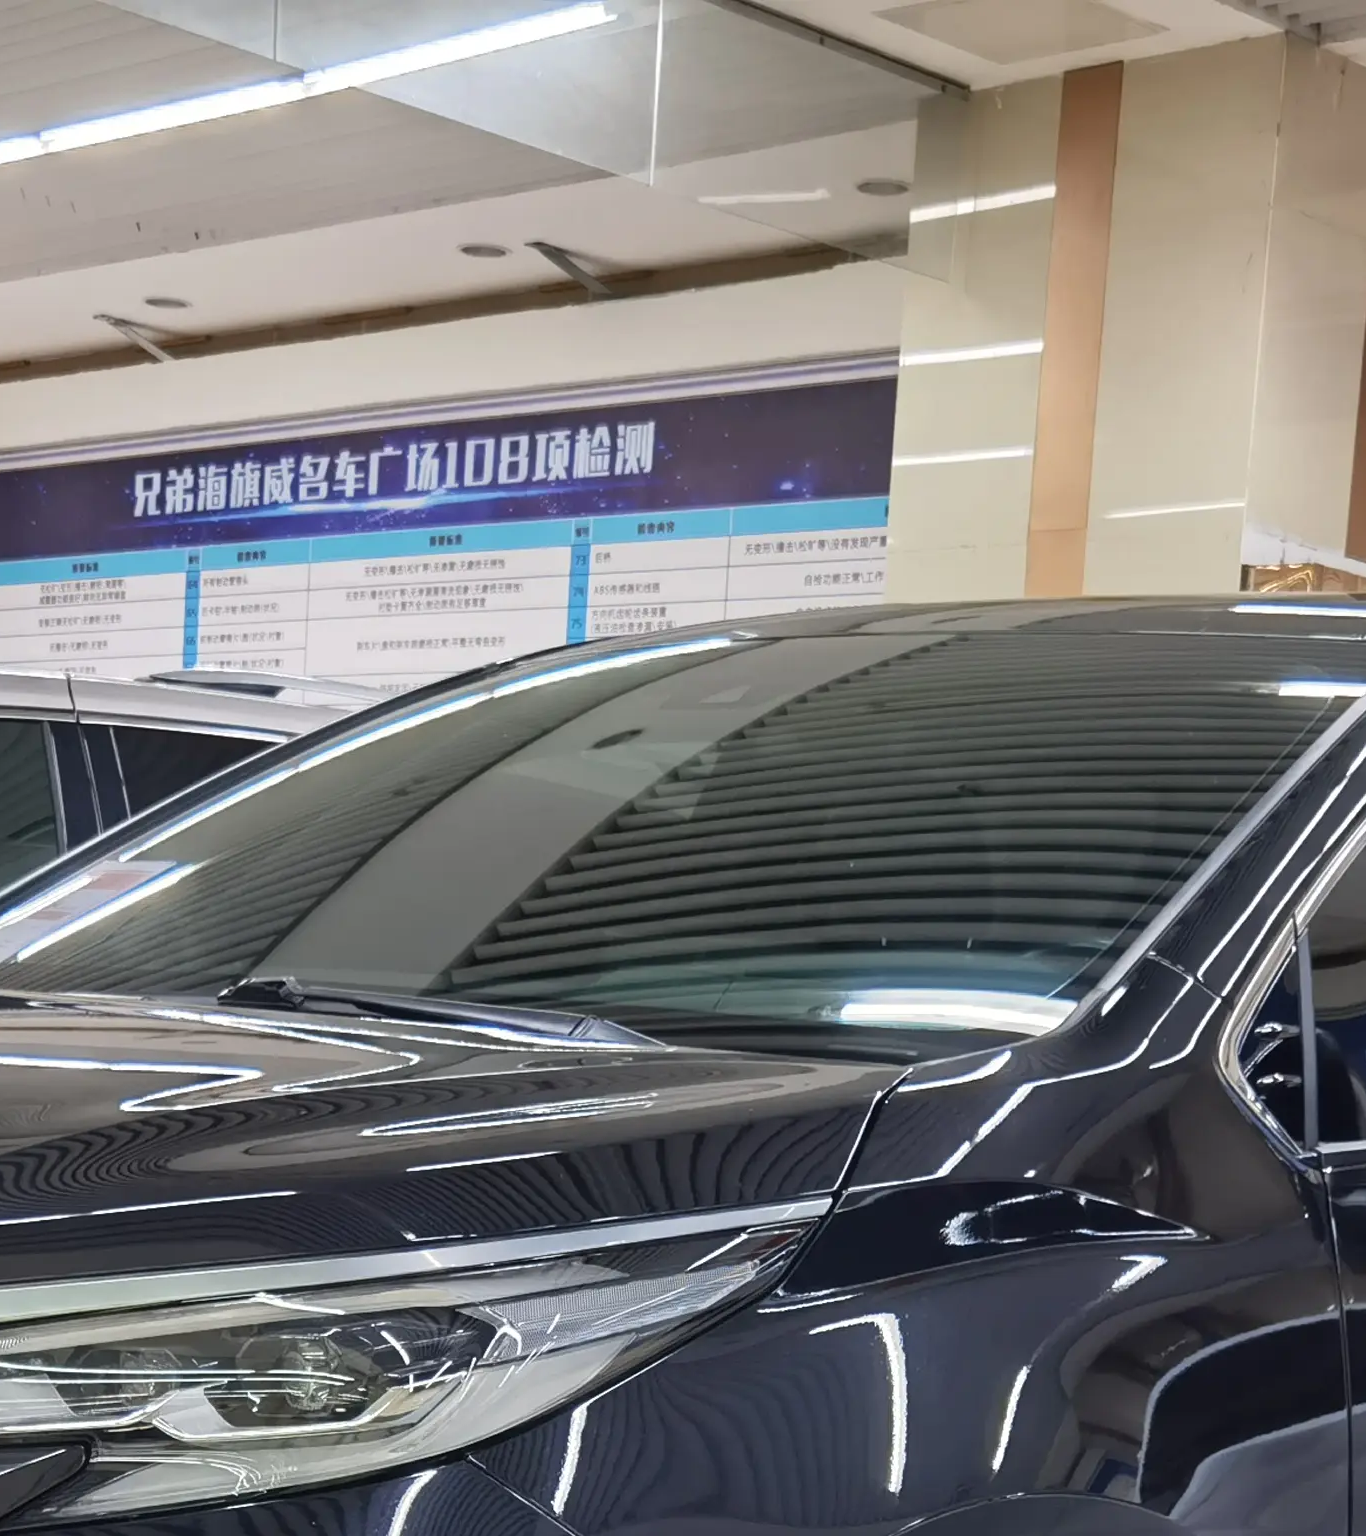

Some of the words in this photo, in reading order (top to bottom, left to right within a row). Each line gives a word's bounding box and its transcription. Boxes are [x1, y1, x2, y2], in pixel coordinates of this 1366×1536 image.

[132, 421, 656, 518] 兄弟海旗威名车广场108项检测
